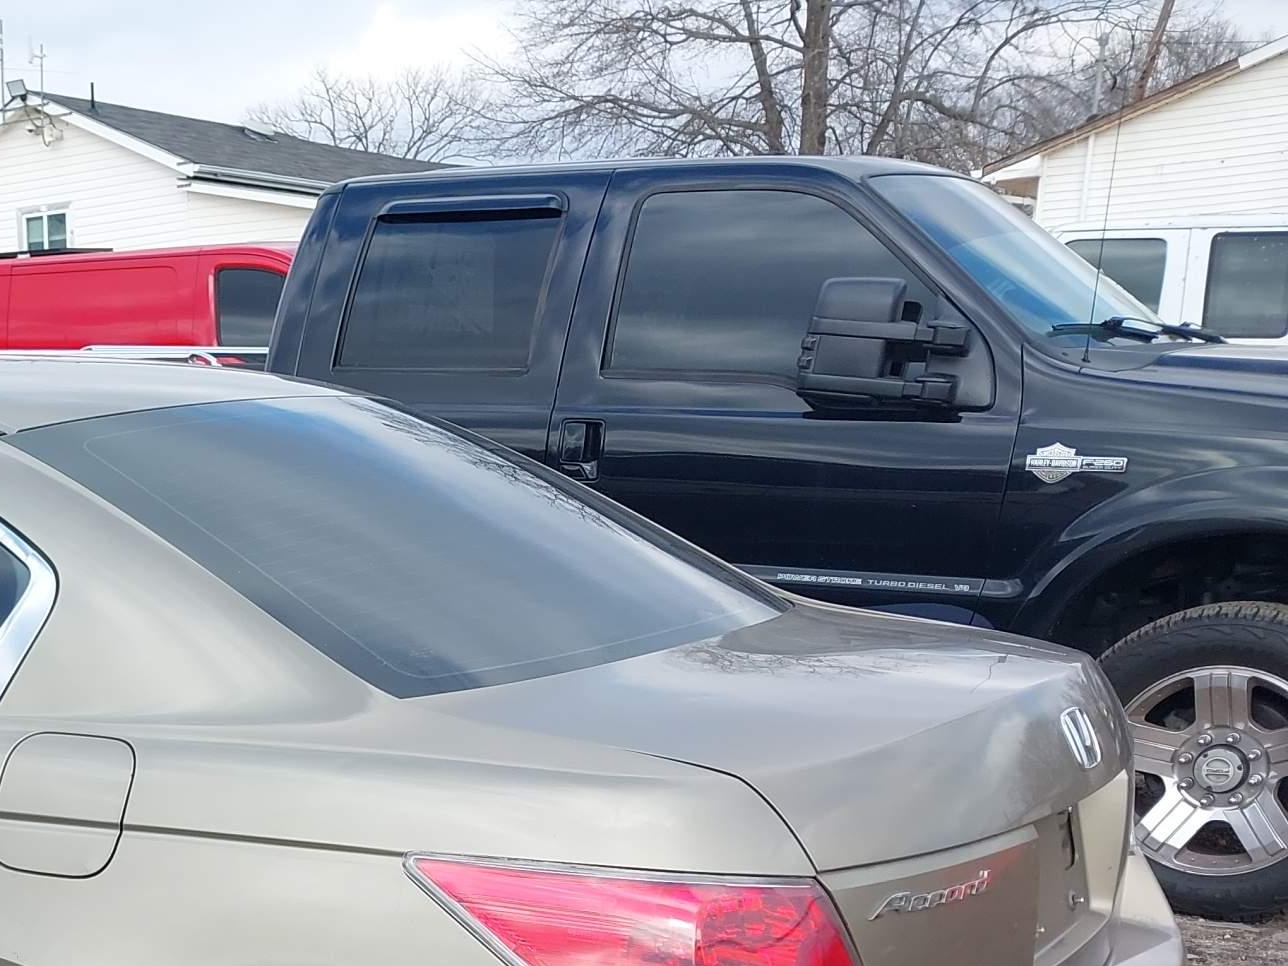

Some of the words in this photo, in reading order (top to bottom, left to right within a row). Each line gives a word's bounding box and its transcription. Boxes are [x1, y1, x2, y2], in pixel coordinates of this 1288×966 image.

[867, 580, 906, 588] TURBO
[907, 582, 948, 590] DIESEL
[866, 869, 992, 921] Accord
